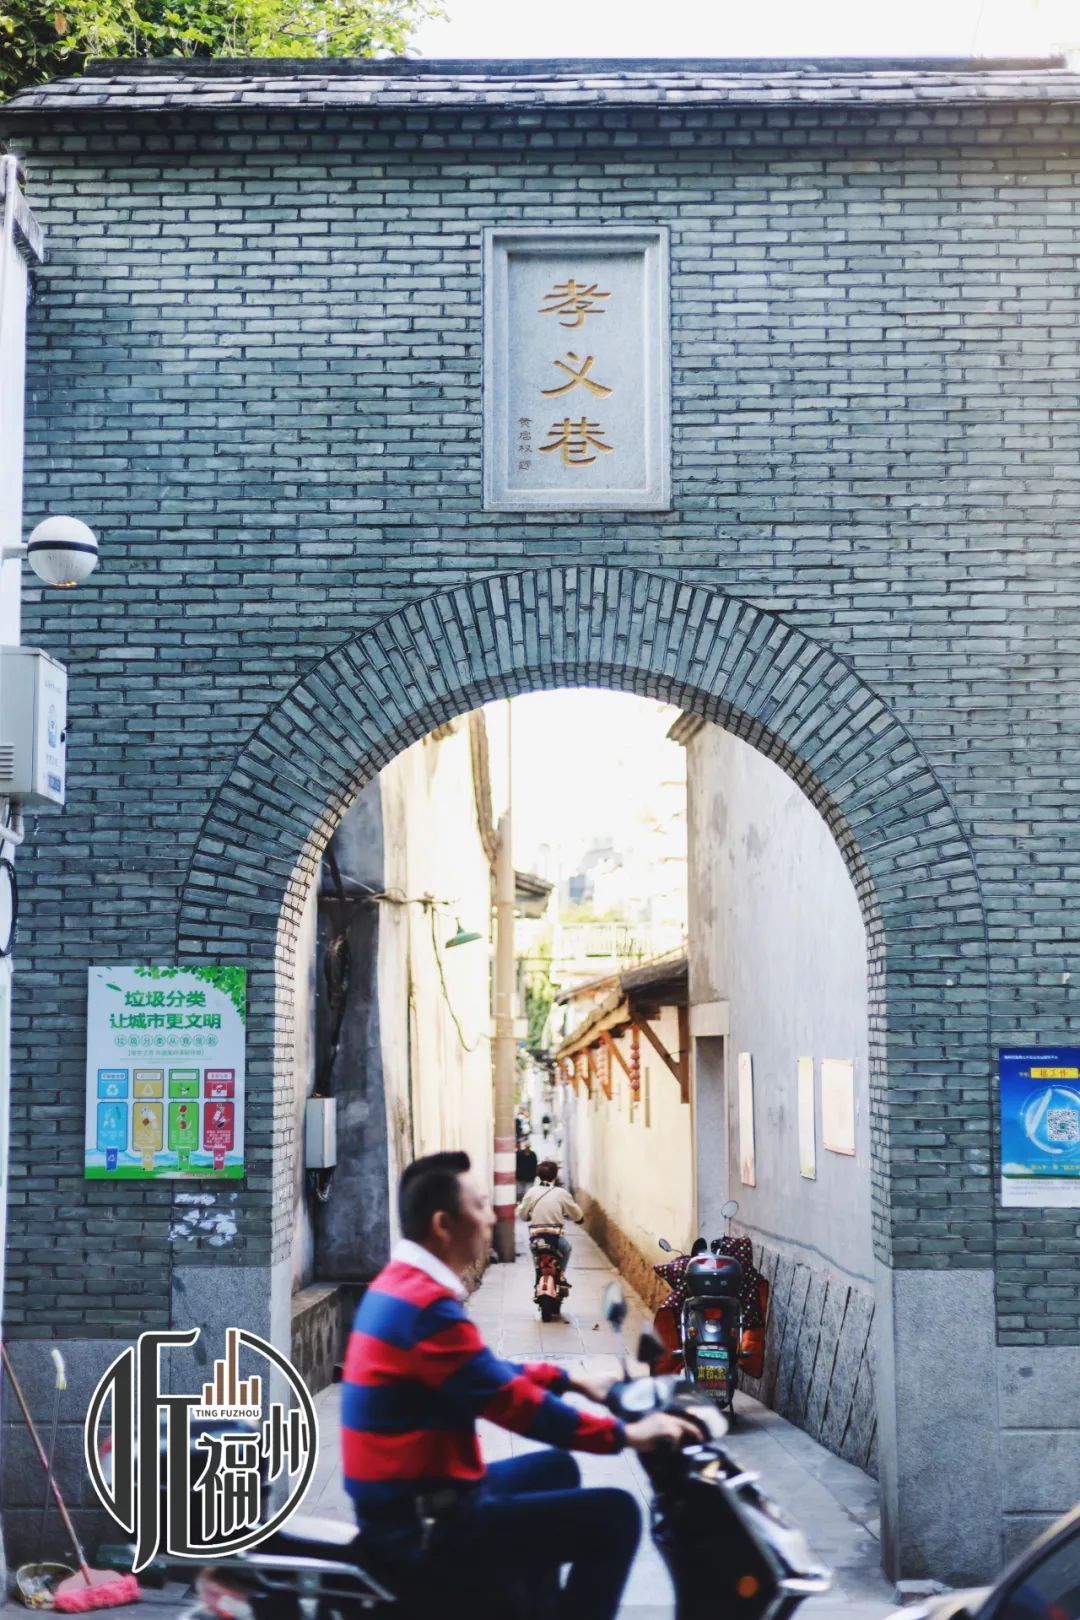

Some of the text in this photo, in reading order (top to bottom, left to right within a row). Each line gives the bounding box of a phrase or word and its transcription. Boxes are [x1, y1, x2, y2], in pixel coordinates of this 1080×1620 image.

[537, 278, 614, 468] 孝义巷
[124, 990, 207, 1008] 垃圾分类
[109, 1013, 222, 1030] 让城市更文明
